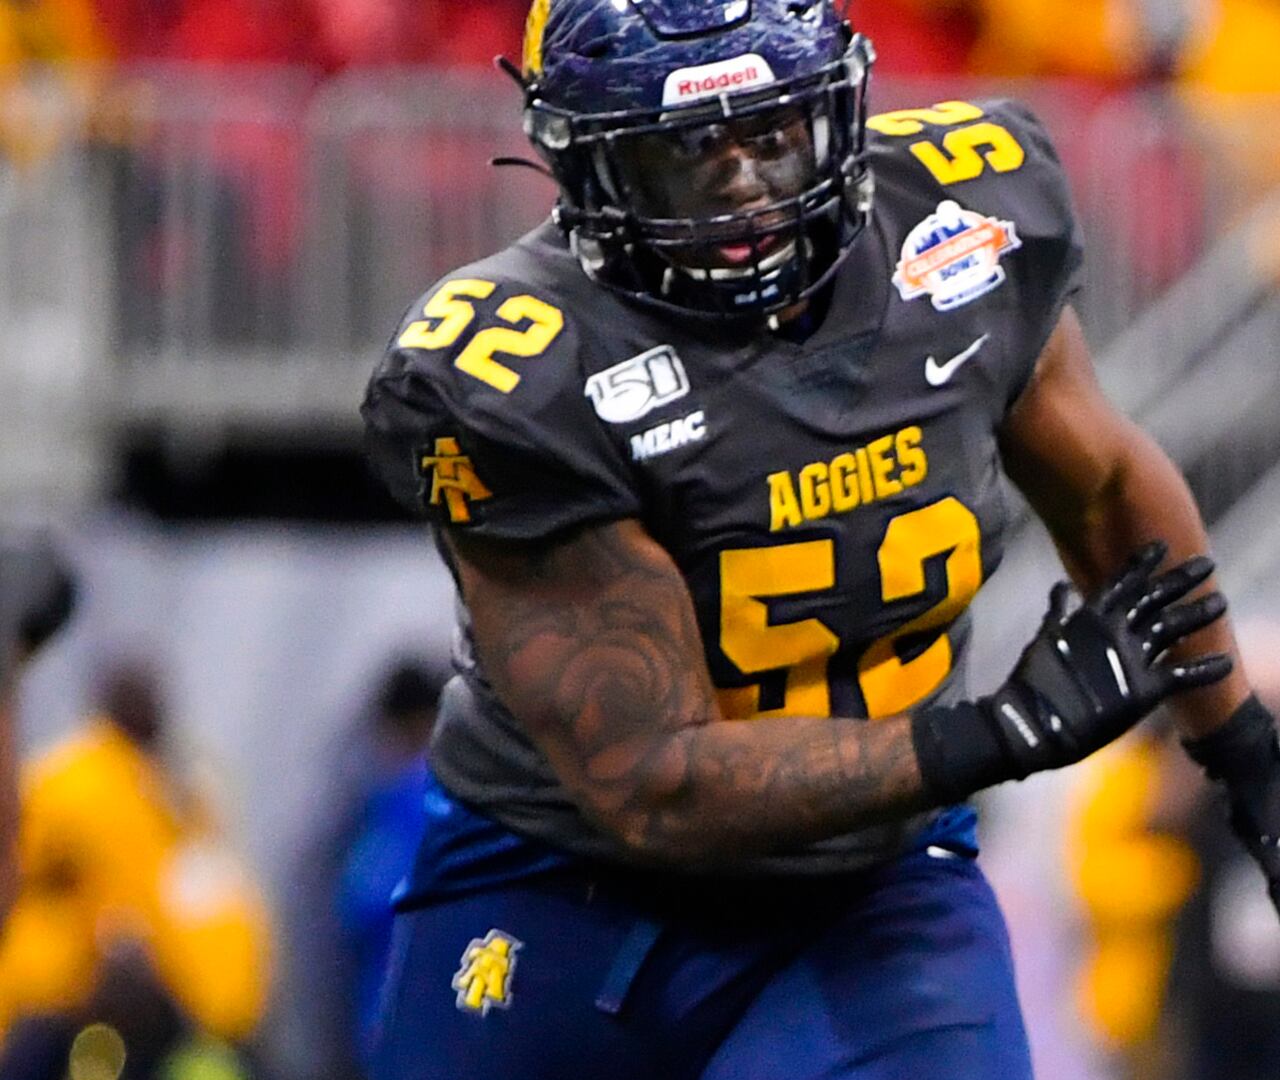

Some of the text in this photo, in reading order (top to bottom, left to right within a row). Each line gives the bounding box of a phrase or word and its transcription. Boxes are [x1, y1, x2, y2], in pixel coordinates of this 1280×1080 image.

[677, 66, 759, 96] Riddell
[867, 101, 1025, 185] 52
[397, 278, 564, 393] 52
[766, 426, 928, 532] AGGIES
[715, 496, 981, 720] 52
